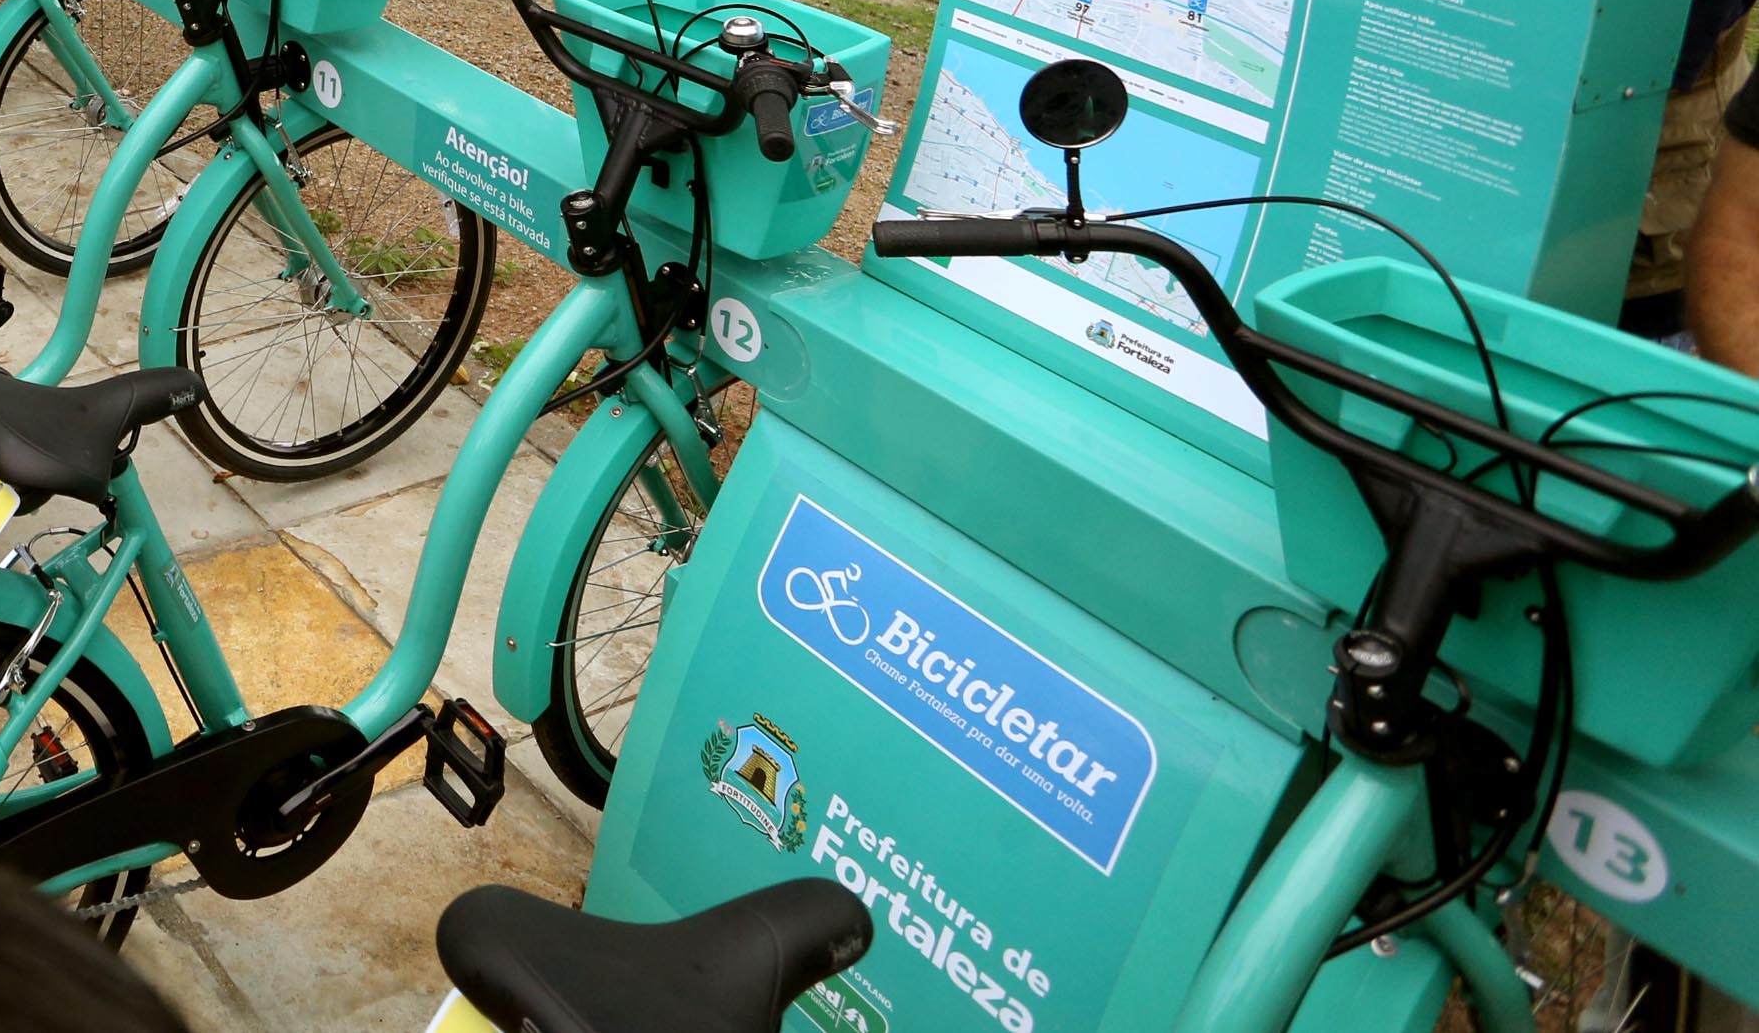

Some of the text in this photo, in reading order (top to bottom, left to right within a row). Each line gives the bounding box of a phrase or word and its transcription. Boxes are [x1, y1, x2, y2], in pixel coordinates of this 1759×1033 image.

[1075, 2, 1090, 14] 97
[1187, 10, 1202, 23] 81
[319, 71, 336, 99] 11
[435, 150, 535, 223] Ao devolver a bike,
[444, 126, 529, 191] Atenção!
[422, 162, 551, 250] verifique se está travada
[720, 309, 754, 353] 12
[1117, 340, 1171, 374] Fortaleza
[1121, 333, 1174, 364] Prefeitura de
[875, 609, 1118, 797] Bicicletar
[864, 648, 1094, 825] Chame Fortaleza pra dar uma volta.
[721, 784, 775, 833] FORTITUDINE
[1569, 809, 1649, 884] 13
[826, 793, 1051, 998] Prefeitura de
[811, 824, 1035, 1033] Fortaleza
